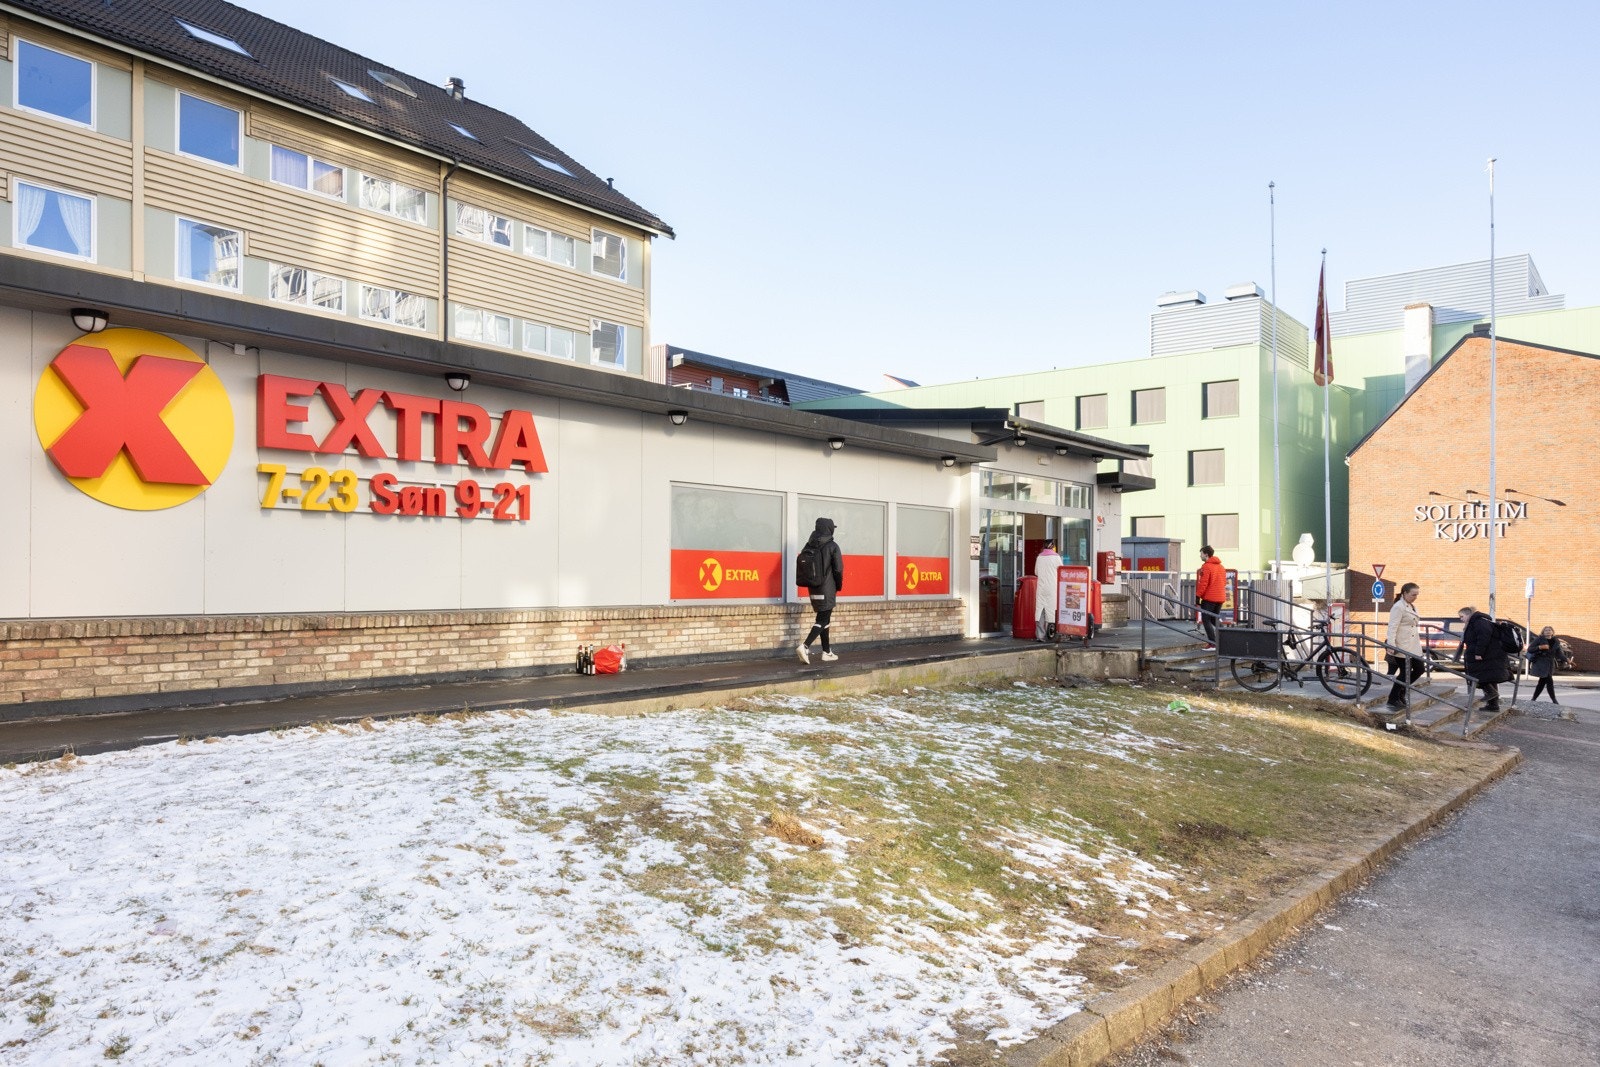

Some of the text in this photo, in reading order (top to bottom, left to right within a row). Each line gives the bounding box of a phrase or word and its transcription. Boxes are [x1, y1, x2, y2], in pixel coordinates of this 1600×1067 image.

[257, 373, 548, 473] EXTRA
[257, 463, 531, 521] 7-23 Søn 9-21
[1414, 501, 1528, 521] SOLHEIM
[1434, 521, 1510, 542] KJØTT
[725, 569, 760, 581] EXTRA
[920, 571, 943, 581] EXTRA
